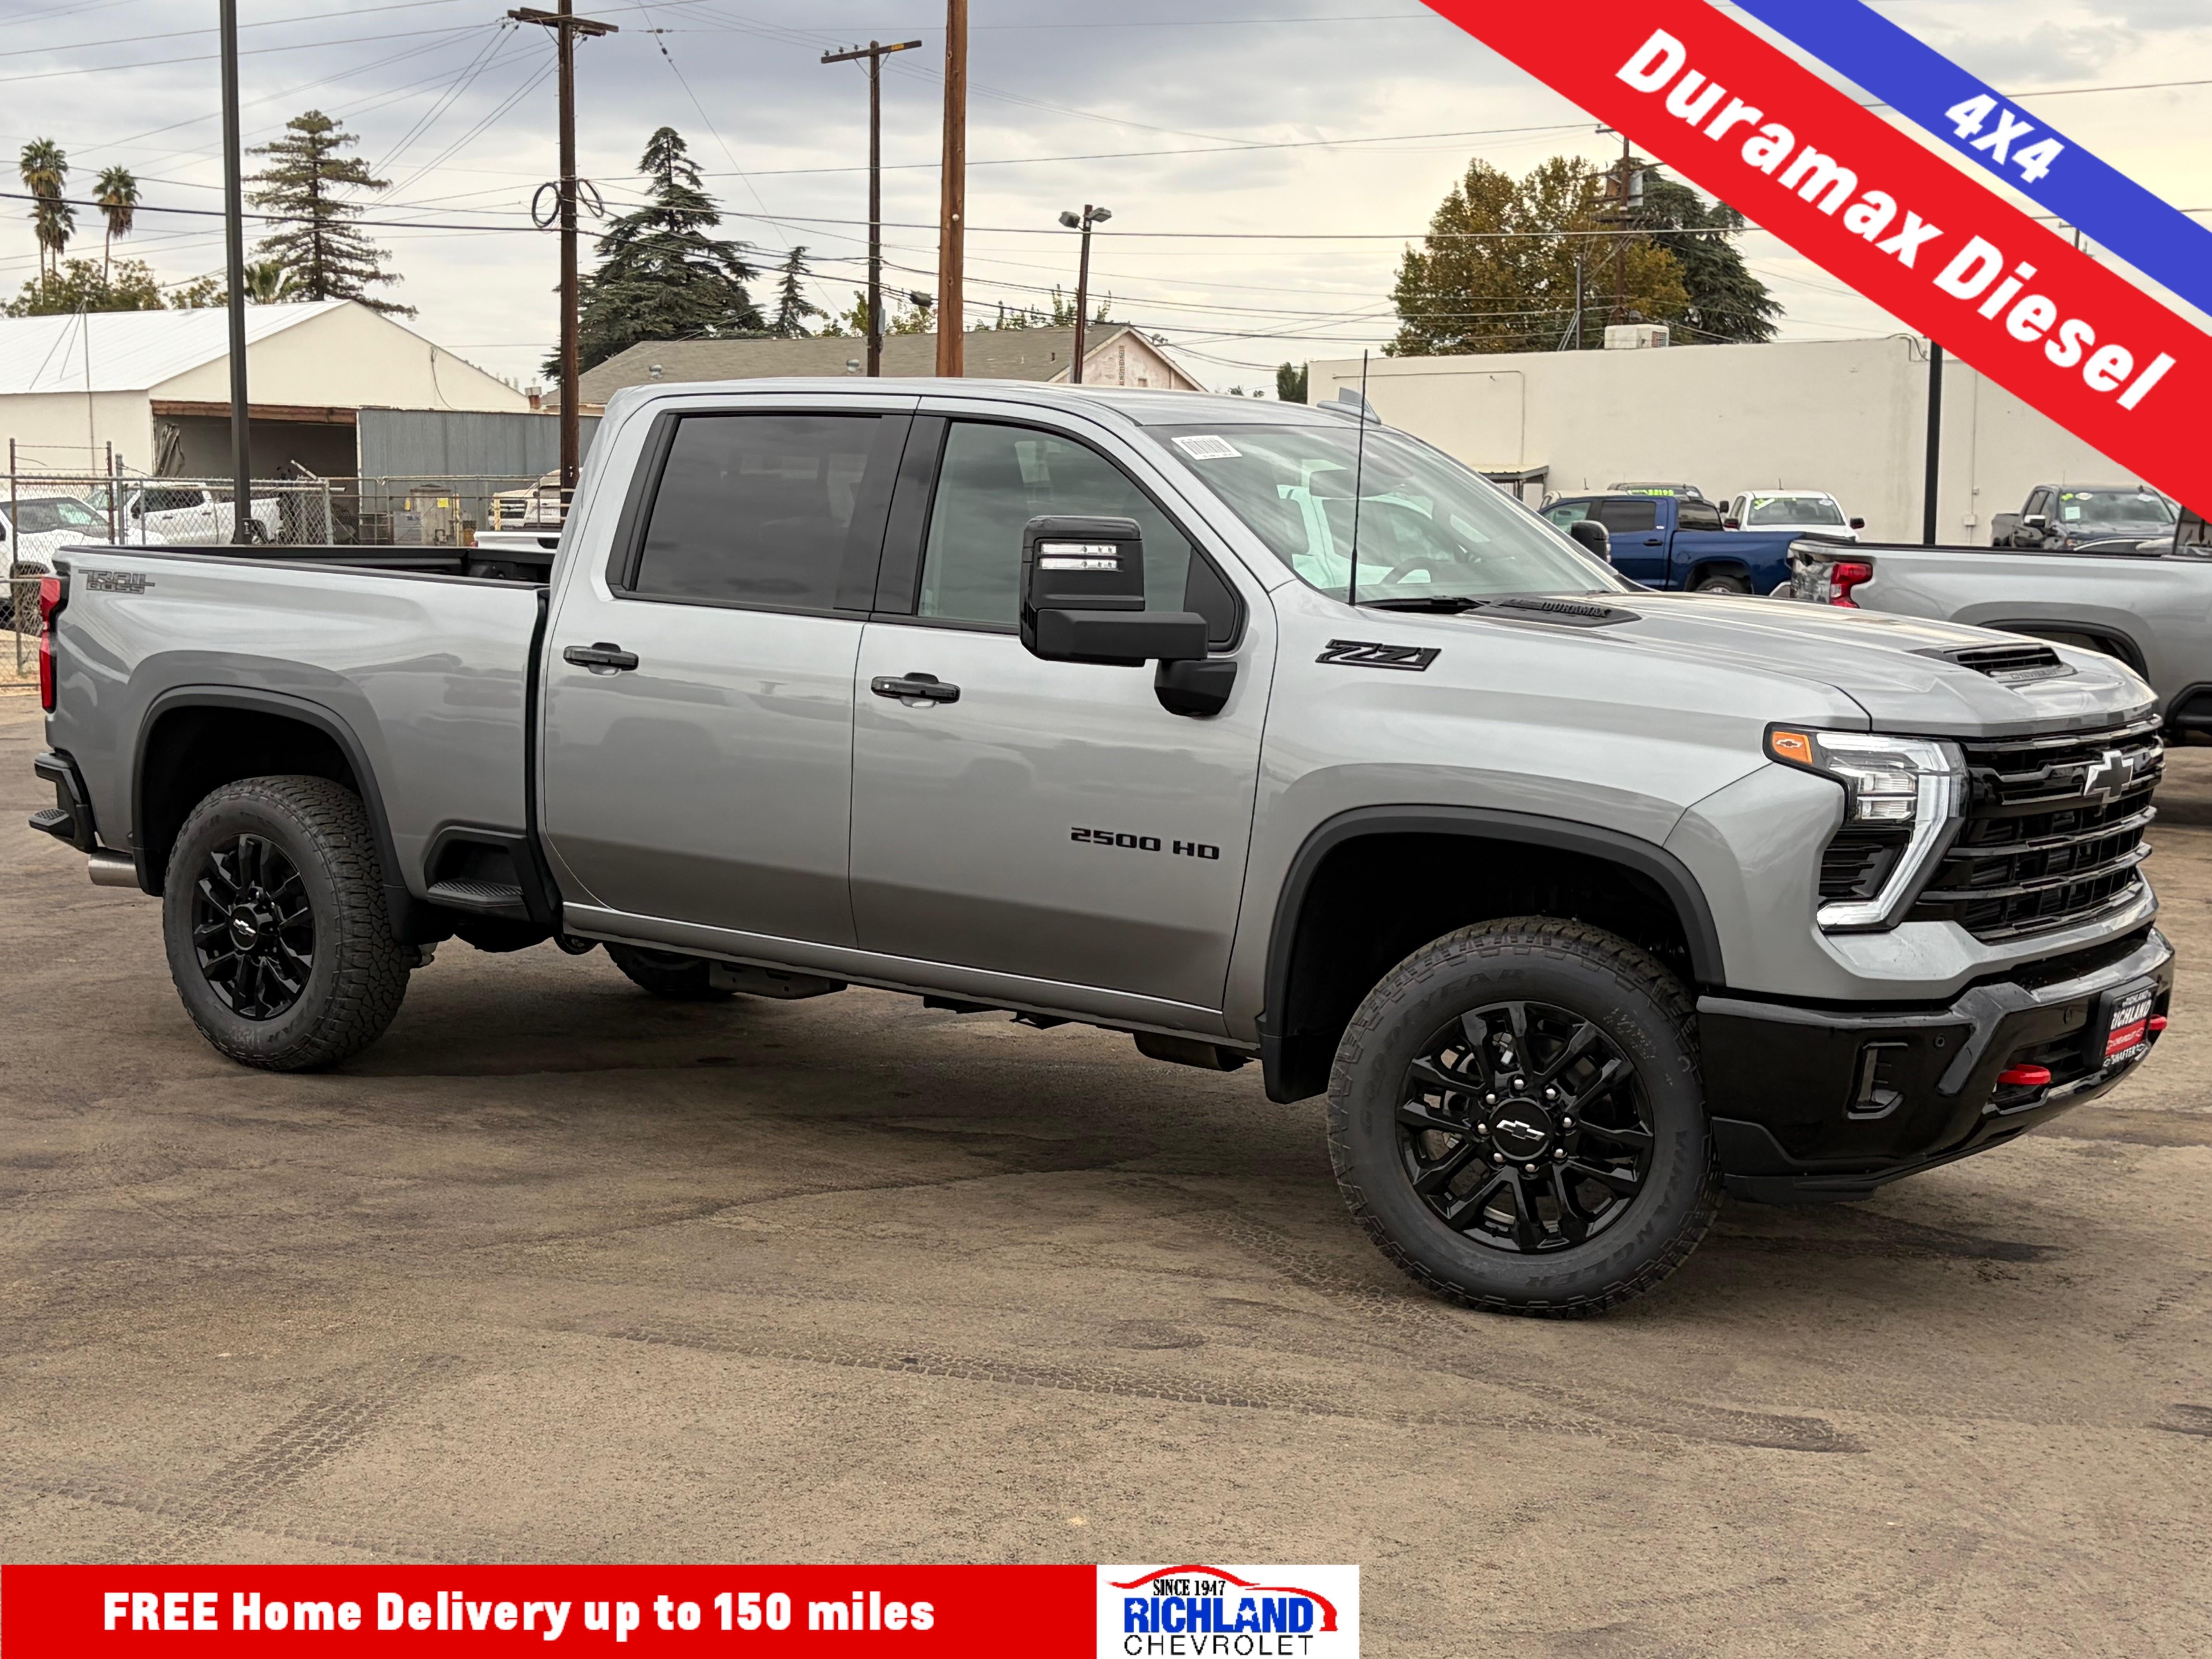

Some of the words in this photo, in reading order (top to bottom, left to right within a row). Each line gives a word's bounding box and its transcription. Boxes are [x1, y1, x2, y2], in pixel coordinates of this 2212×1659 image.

[78, 569, 155, 587] TRAIL
[86, 581, 145, 594] BOSS
[1542, 601, 1611, 618] DURAMAX
[1315, 639, 1441, 672] Z71
[1071, 827, 1161, 852] 2500
[1173, 840, 1219, 860] HD
[2111, 999, 2152, 1030] RICHLAND
[1527, 1129, 1691, 1289] WRANGLER
